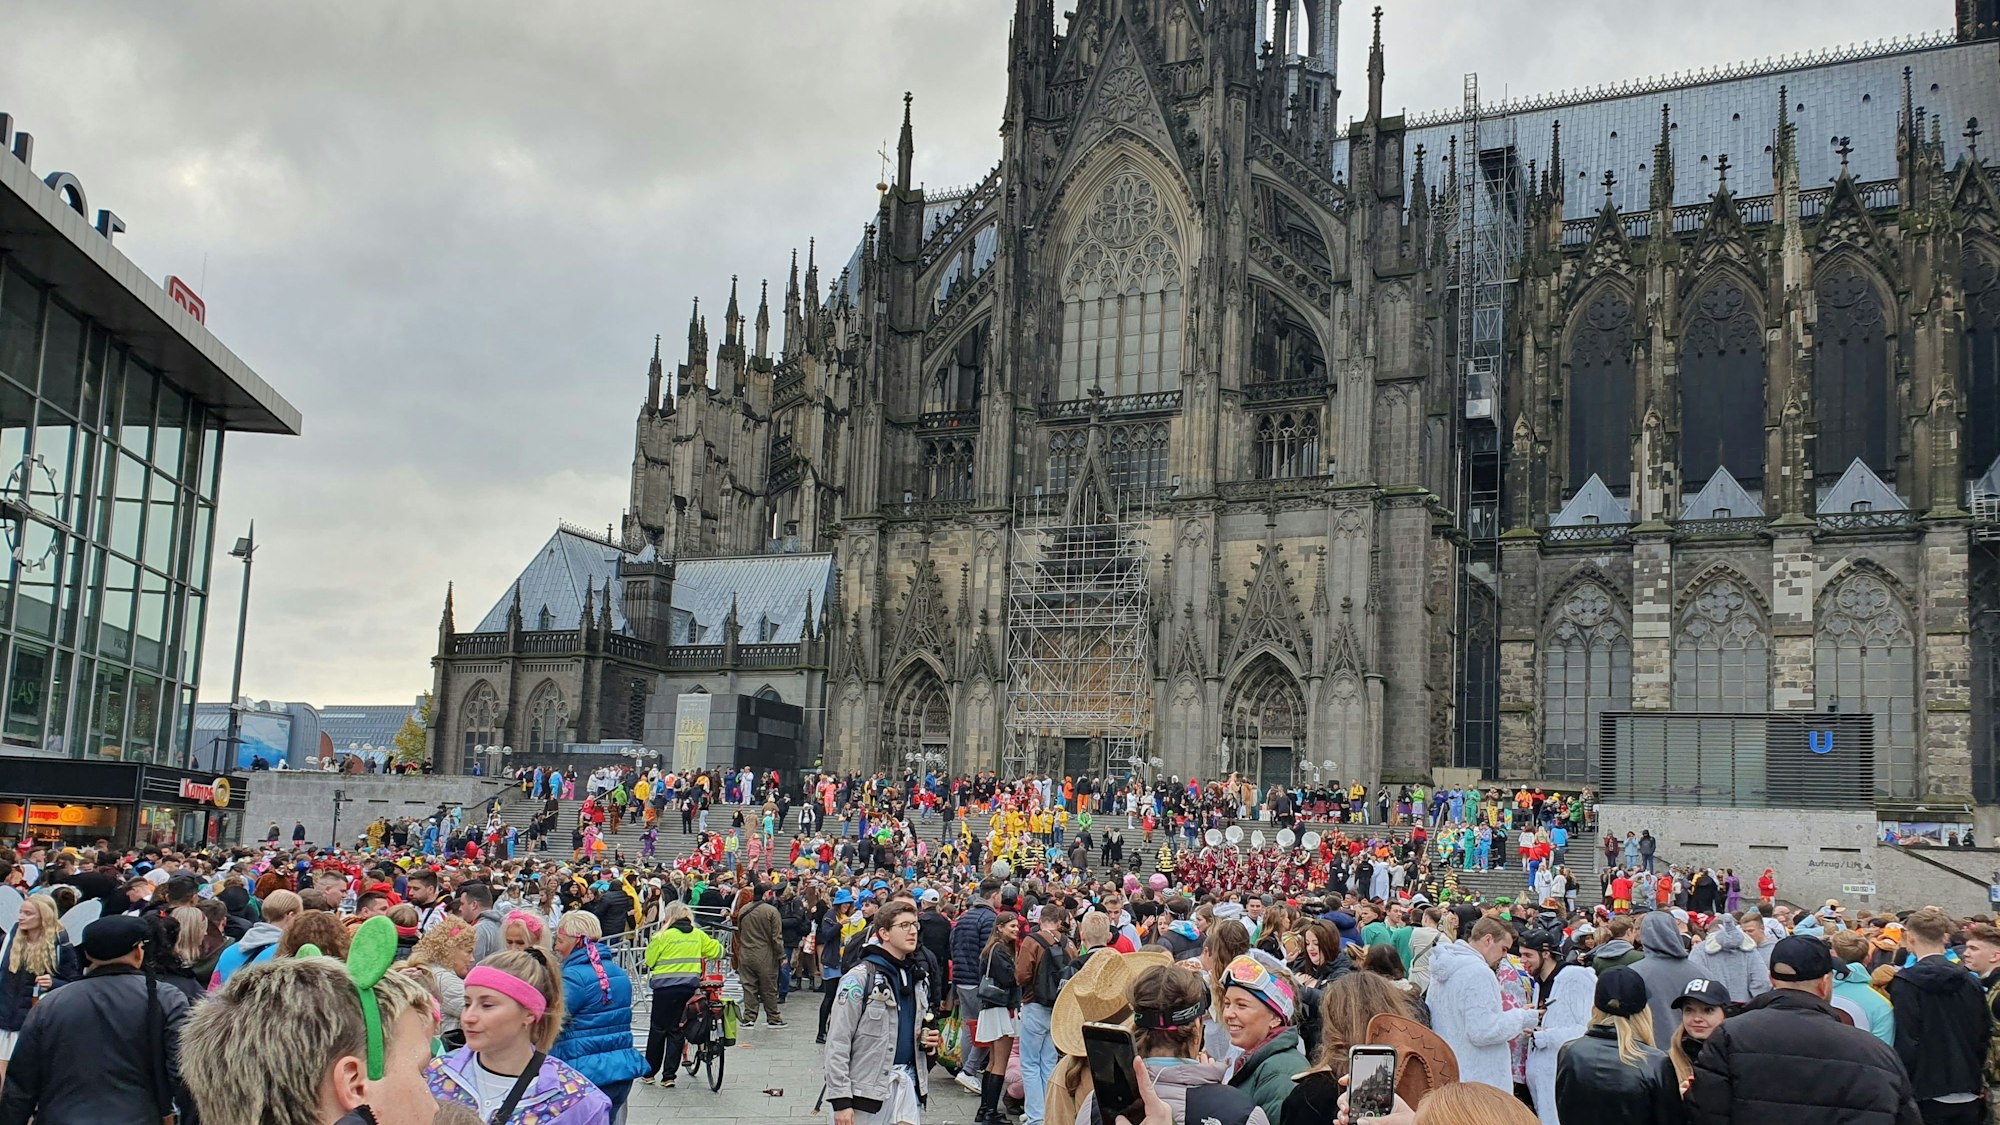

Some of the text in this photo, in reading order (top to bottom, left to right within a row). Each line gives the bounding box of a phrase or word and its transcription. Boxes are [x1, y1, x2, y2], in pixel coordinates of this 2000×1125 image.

[1809, 730, 1833, 754] U
[1808, 859, 1840, 869] Aufzug
[1684, 978, 1710, 995] FBI
